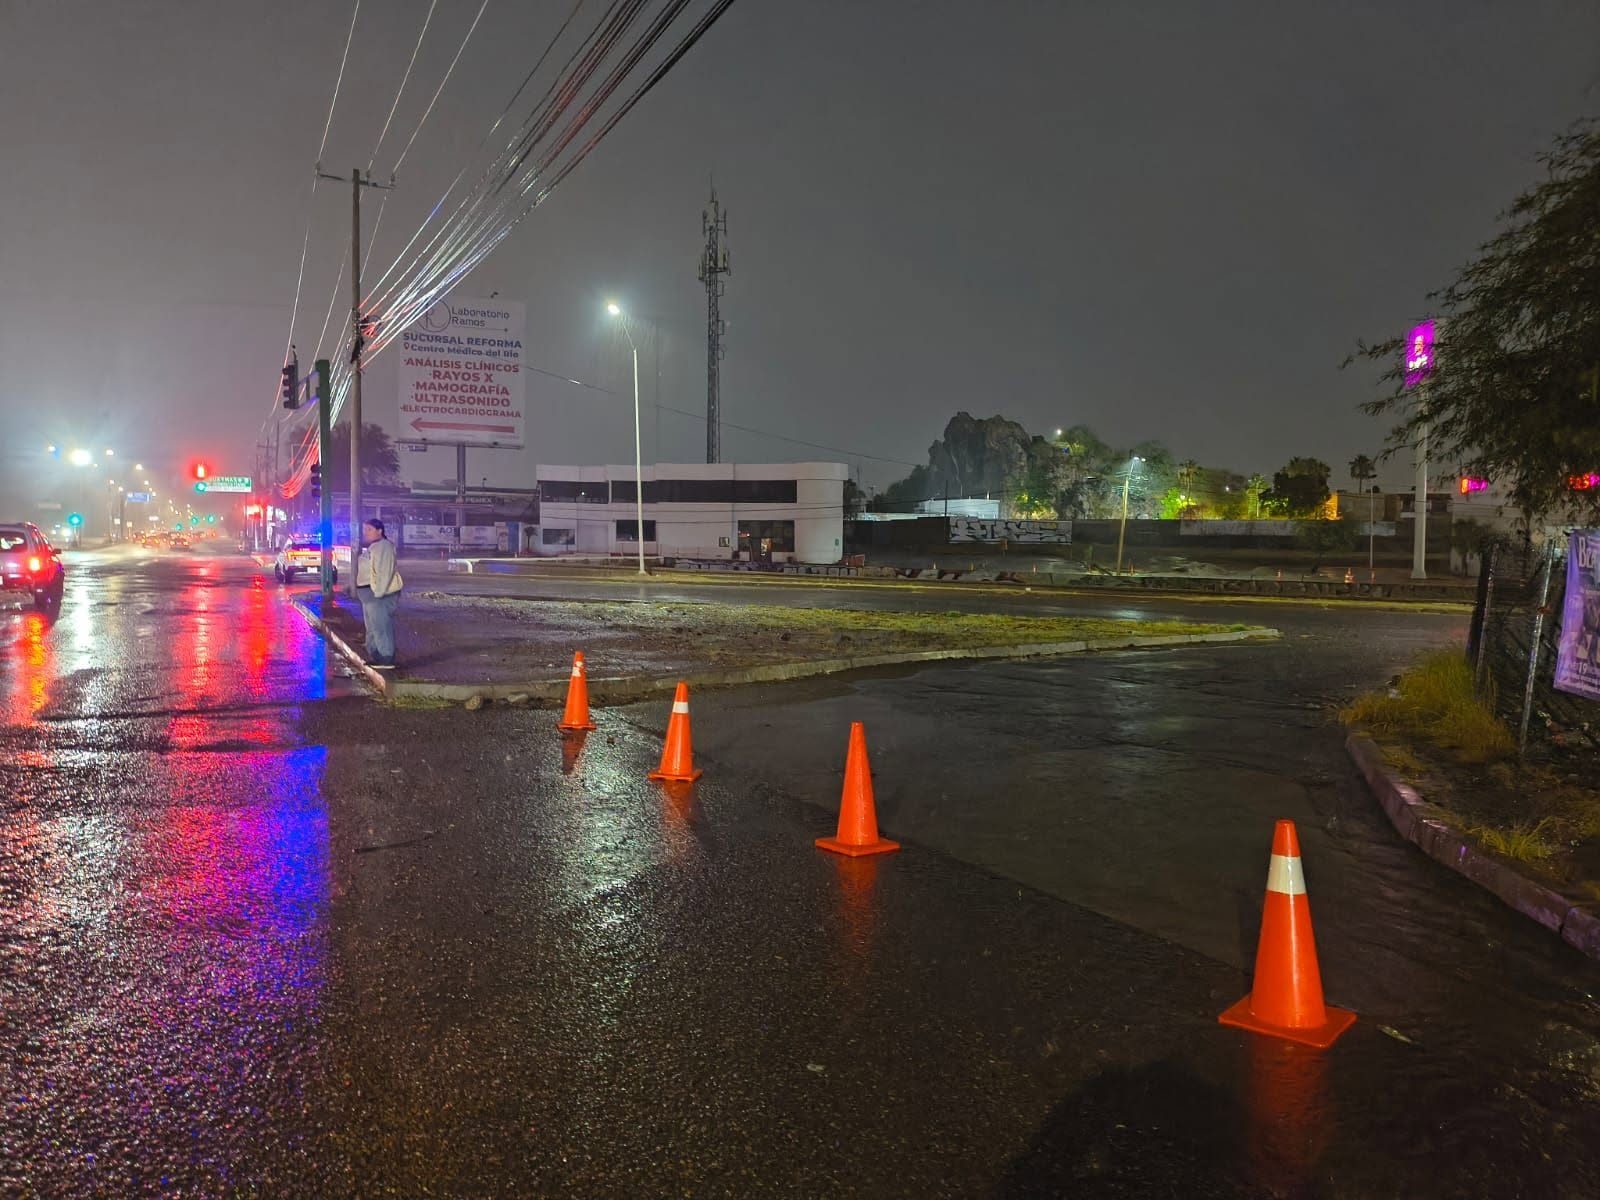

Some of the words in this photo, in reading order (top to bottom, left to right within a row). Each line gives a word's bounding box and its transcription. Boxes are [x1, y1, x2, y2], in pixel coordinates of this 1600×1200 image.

[451, 306, 510, 319] Laboratorio
[451, 316, 486, 327] Ramos
[403, 332, 464, 345] SUCURSAL
[467, 337, 522, 349] REFORMA
[411, 344, 445, 352] Centro
[485, 348, 501, 358] del
[465, 361, 519, 372] CLÍNICOS
[432, 369, 481, 382] RAYOS
[484, 373, 494, 383] X
[415, 381, 510, 395] MAMOGRAFÍA
[414, 393, 511, 407] ULTRASONIDO
